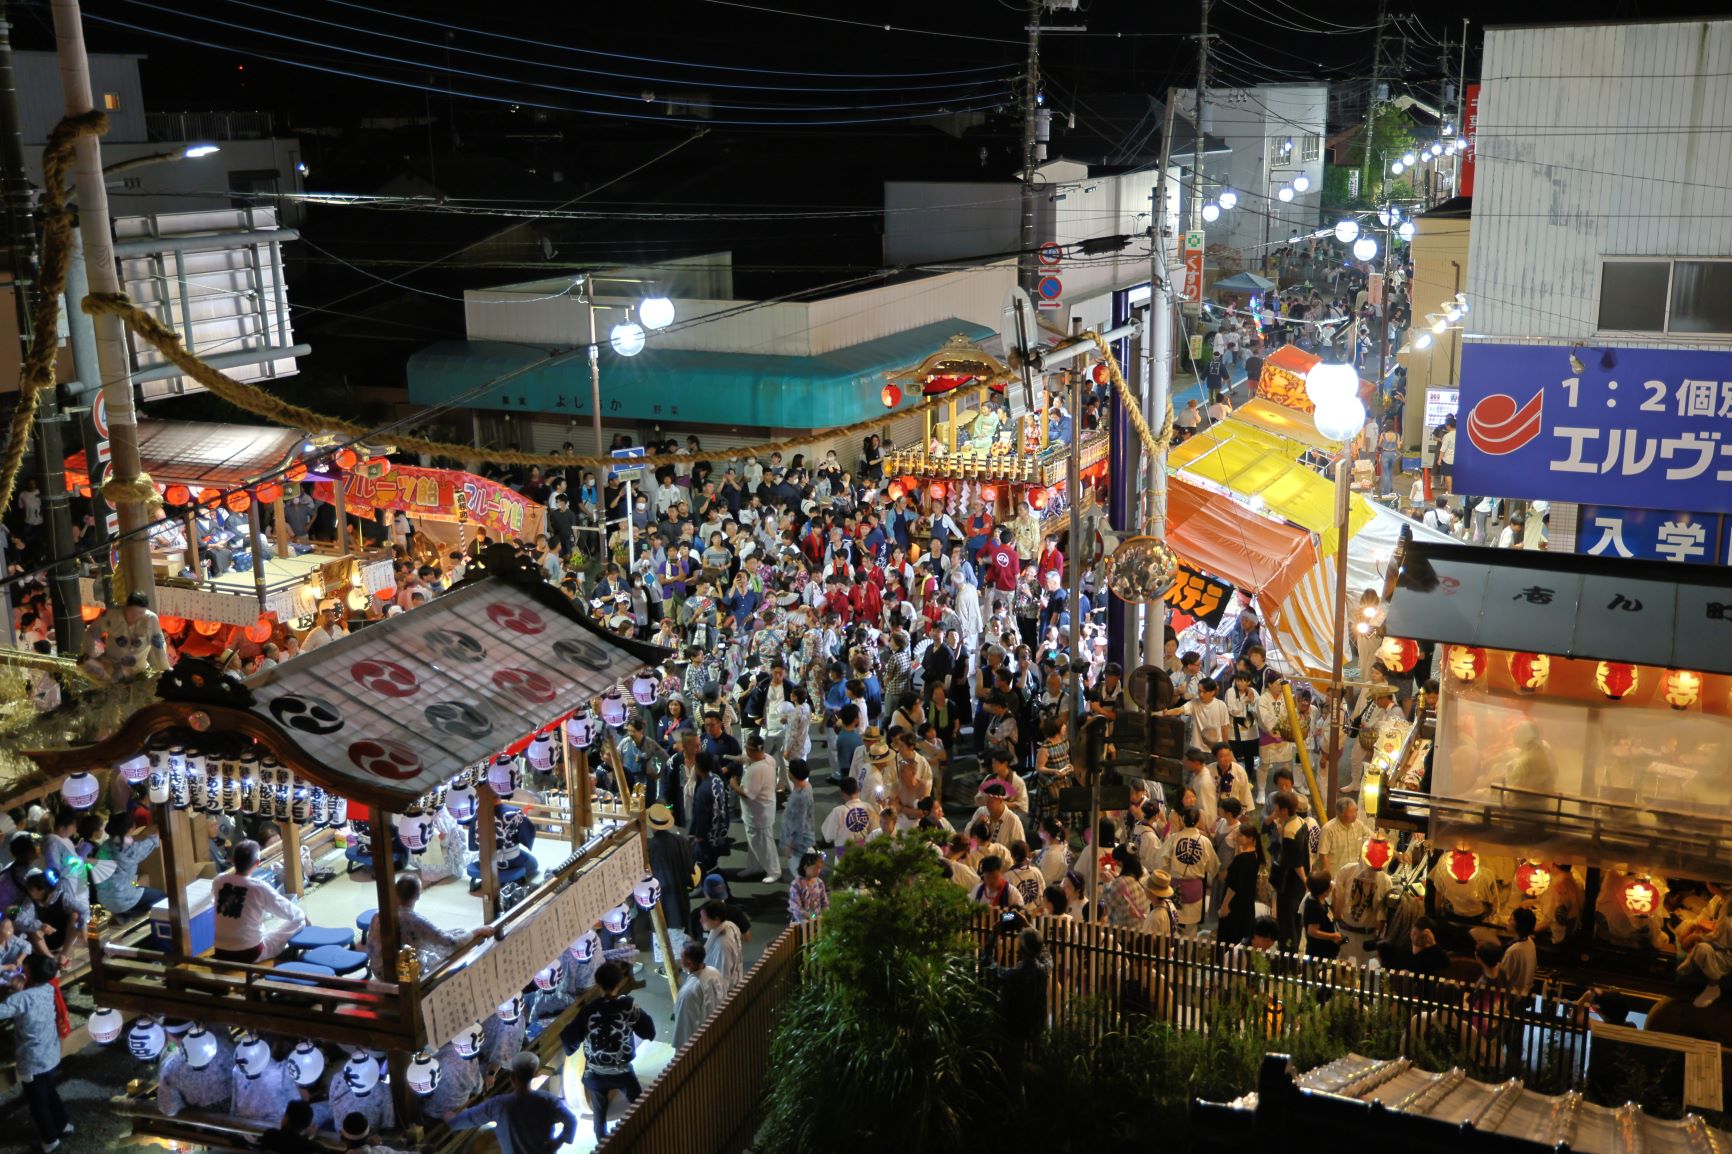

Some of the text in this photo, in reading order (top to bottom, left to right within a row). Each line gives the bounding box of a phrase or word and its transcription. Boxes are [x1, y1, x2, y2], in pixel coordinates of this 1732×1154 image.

[1187, 254, 1200, 300] くすり
[555, 394, 622, 412] よしか
